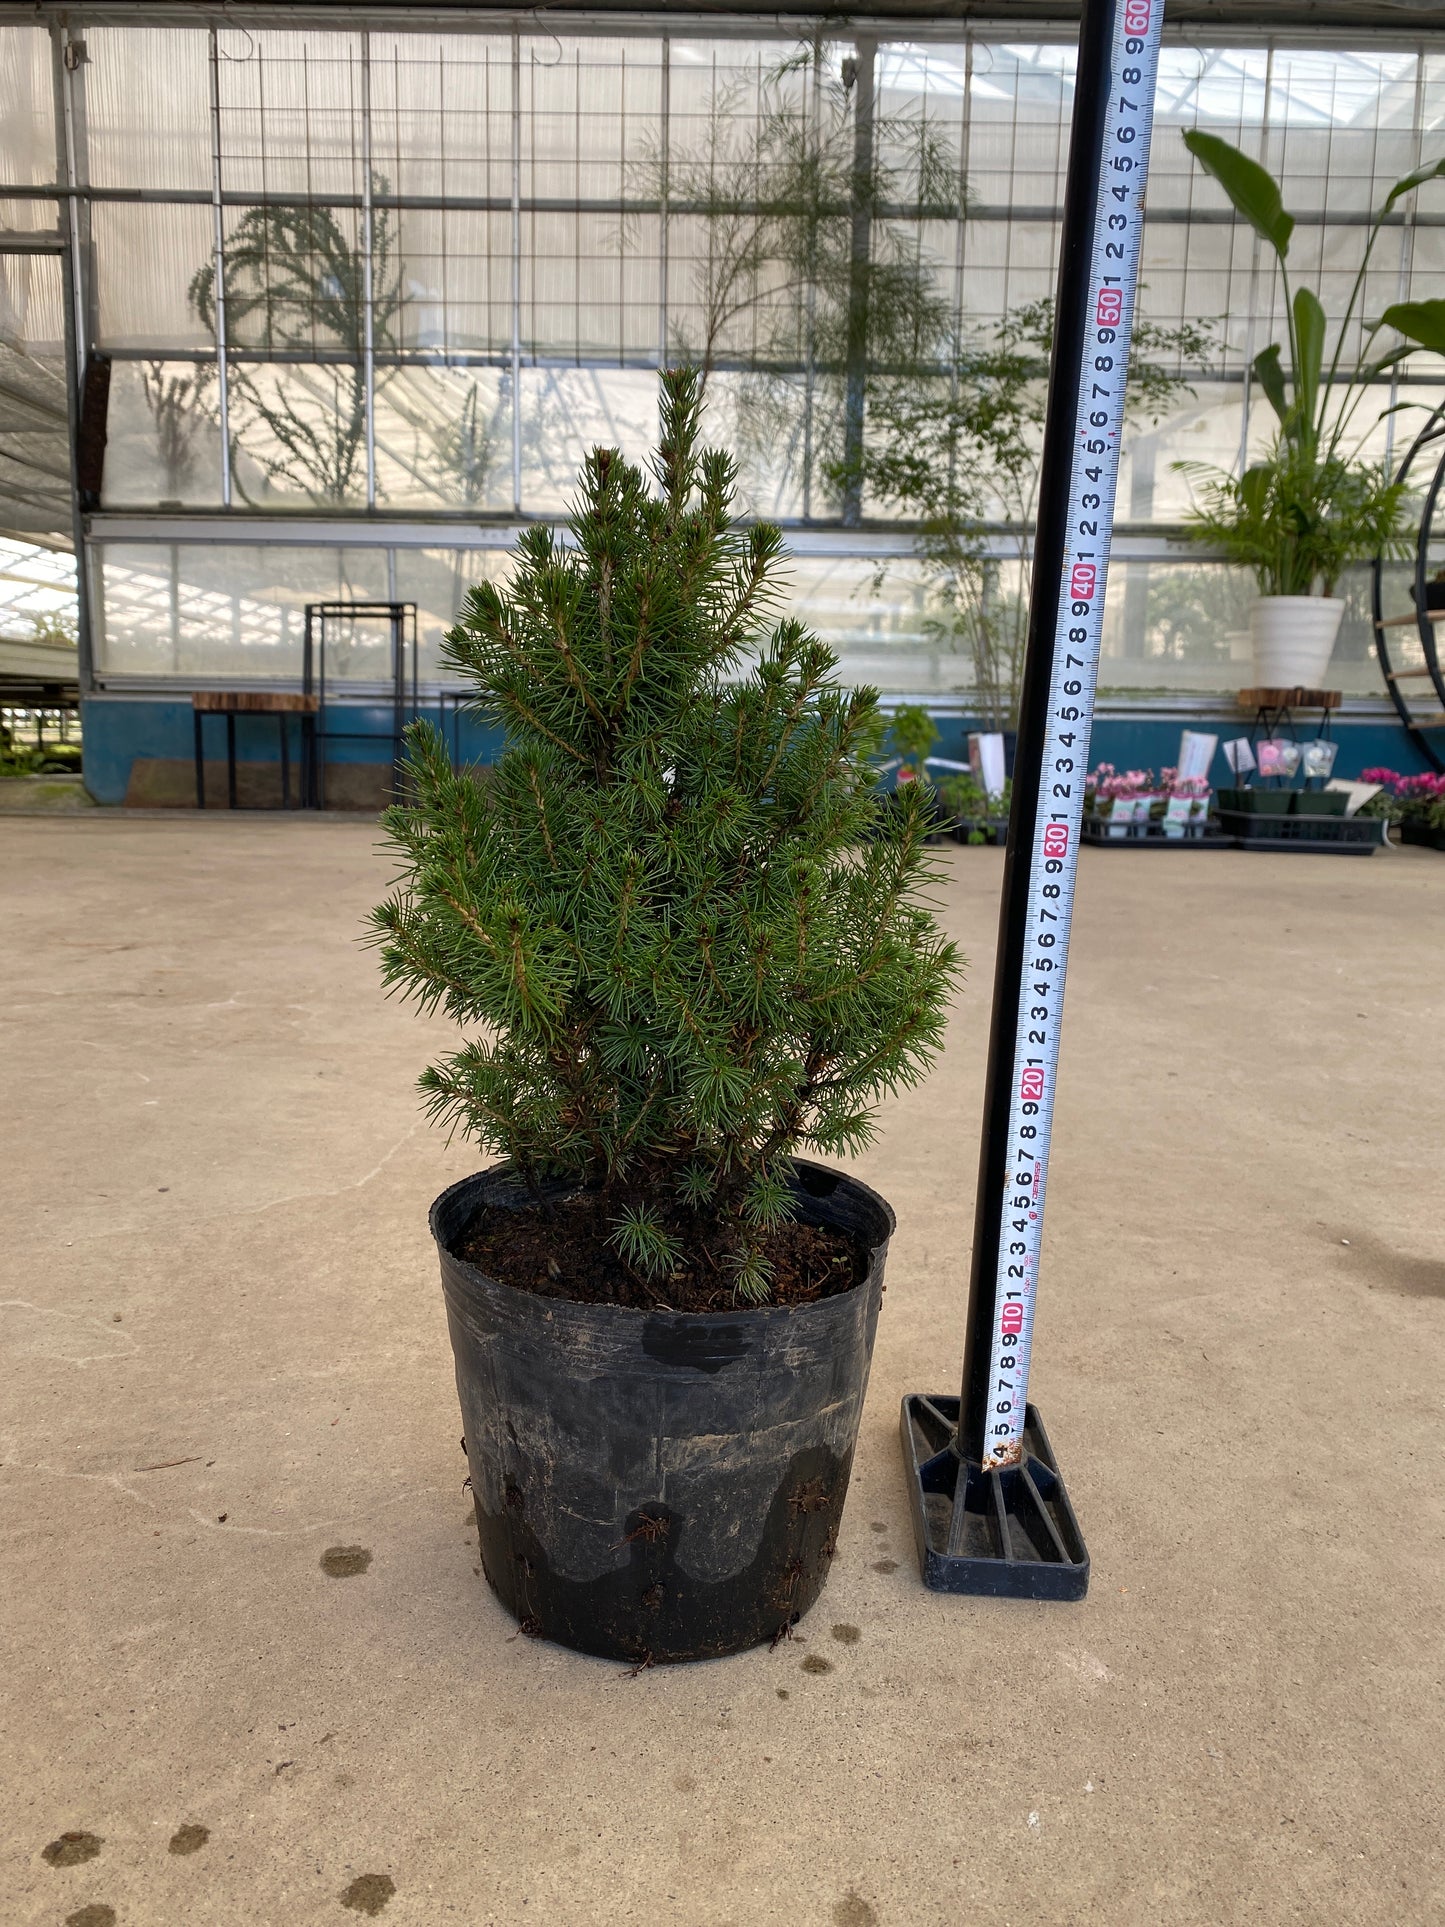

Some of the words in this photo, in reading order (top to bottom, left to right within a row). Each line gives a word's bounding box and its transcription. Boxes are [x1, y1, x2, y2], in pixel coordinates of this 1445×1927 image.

[1126, 0, 1149, 31] 60
[1125, 38, 1144, 54] 9
[1122, 68, 1142, 84] 8
[1119, 96, 1138, 113] 7
[1116, 127, 1136, 144] 6
[1114, 156, 1133, 172] 5
[1112, 185, 1130, 202] 4
[1108, 214, 1127, 231] 3
[1106, 242, 1124, 259] 2
[1103, 276, 1121, 286] 1
[1099, 292, 1121, 322] 50
[1097, 328, 1116, 344] 9
[1094, 356, 1114, 372] 8
[1092, 383, 1110, 399] 7
[1090, 411, 1108, 427] 6
[1087, 439, 1106, 454] 5
[1085, 466, 1102, 482] 4
[1082, 494, 1100, 510] 3
[1079, 520, 1098, 536] 2
[1077, 552, 1094, 562] 1
[1073, 567, 1095, 595] 40
[1072, 601, 1090, 616] 9
[1068, 628, 1087, 643] 8
[1066, 654, 1084, 668] 7
[1064, 680, 1082, 696] 6
[1061, 707, 1079, 721] 5
[1058, 732, 1076, 748] 4
[1056, 758, 1074, 773] 3
[1053, 784, 1071, 798] 2
[1051, 814, 1068, 822] 1
[1046, 827, 1067, 853] 30
[1045, 859, 1063, 874] 9
[1042, 884, 1060, 899] 8
[1040, 908, 1058, 922] 7
[1038, 934, 1056, 948] 6
[1035, 958, 1053, 972] 5
[1034, 982, 1050, 996] 4
[1031, 1006, 1048, 1020] 3
[1028, 1030, 1046, 1044] 2
[1026, 1058, 1043, 1066] 1
[1022, 1071, 1043, 1096] 20
[1022, 1102, 1039, 1115] 9
[1020, 1126, 1037, 1139] 8
[1018, 1149, 1034, 1162] 7
[1016, 1172, 1032, 1186] 6
[1014, 1196, 1030, 1209] 5
[1012, 1218, 1028, 1232] 4
[1010, 1242, 1026, 1255] 3
[1008, 1265, 1024, 1278] 2
[1006, 1292, 1022, 1300] 1
[1003, 1306, 1022, 1329] 10
[1002, 1333, 1018, 1346] 9
[1000, 1356, 1016, 1369] 8
[998, 1379, 1013, 1392] 7
[996, 1400, 1012, 1414] 6
[994, 1423, 1010, 1436] 5
[993, 1445, 1008, 1458] 4
